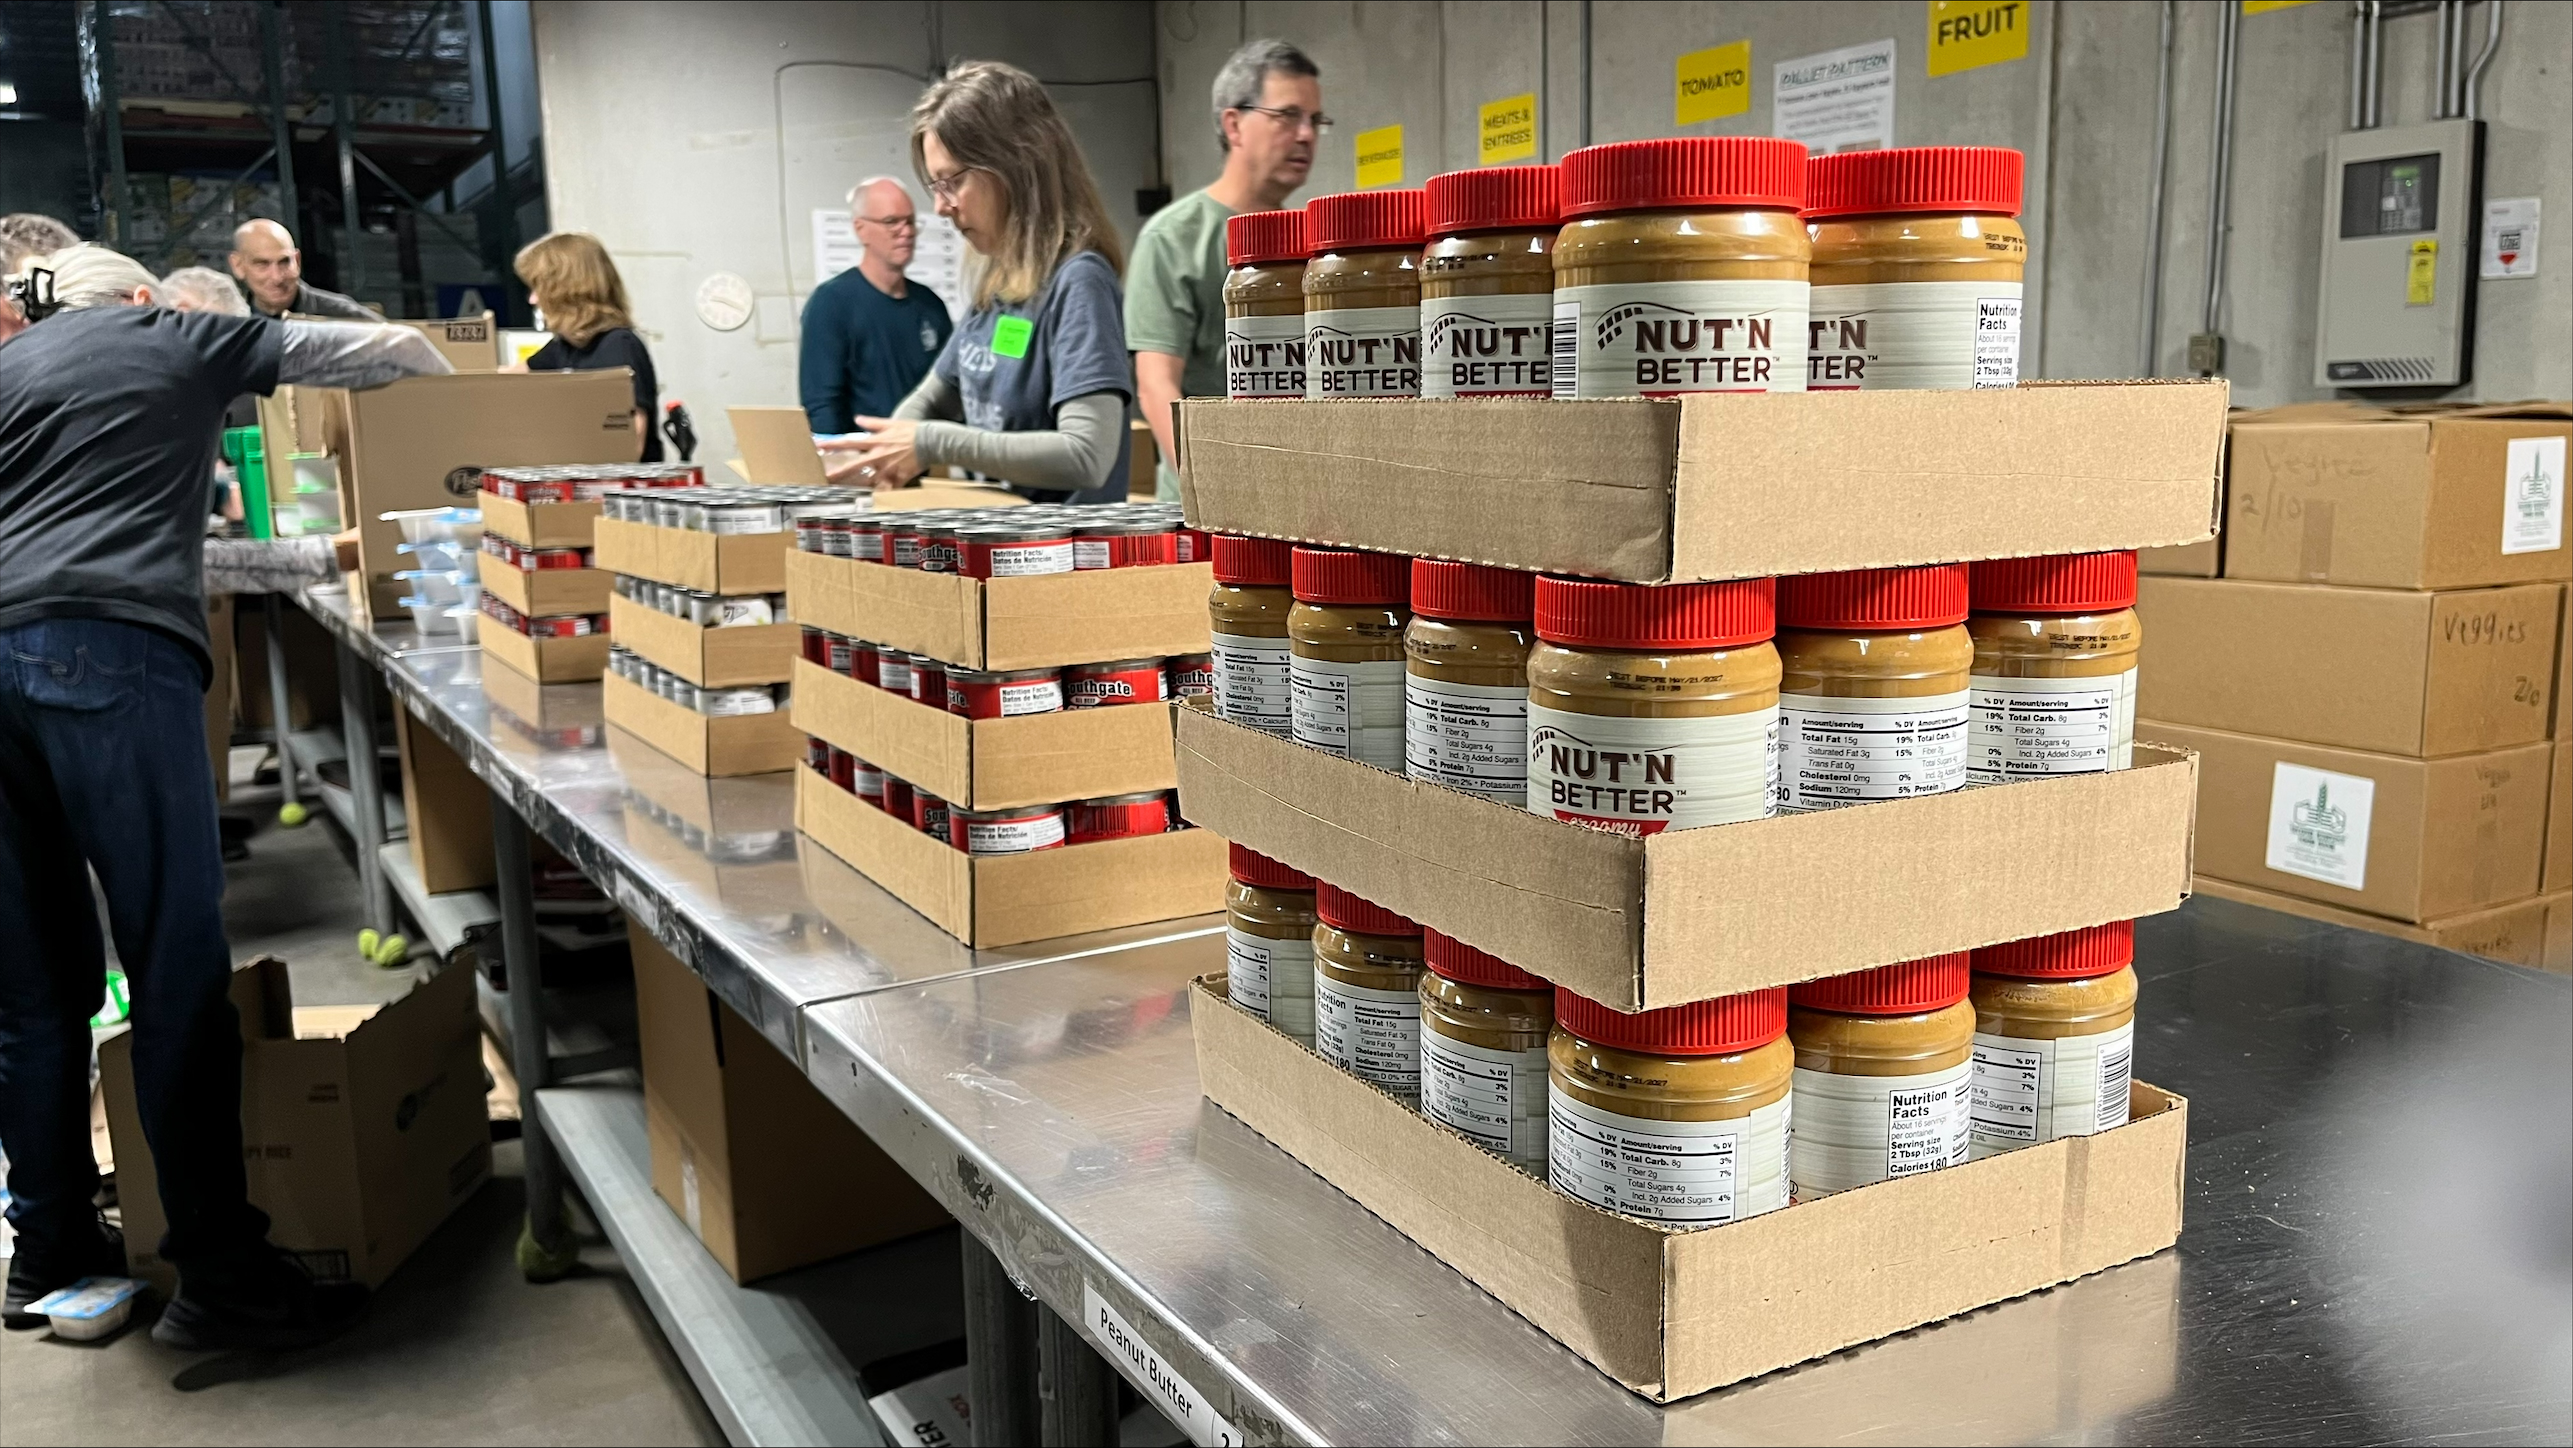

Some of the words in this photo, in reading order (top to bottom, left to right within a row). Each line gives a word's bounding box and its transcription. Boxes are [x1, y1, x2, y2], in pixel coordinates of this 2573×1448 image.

[1937, 3, 2019, 47] FRUIT
[1681, 69, 1746, 97] TOMATO
[1980, 304, 2017, 317] Nutrition
[1979, 318, 2007, 331] Facts
[1635, 318, 1773, 352] NUT'N
[1808, 318, 1868, 350] T'N
[1230, 343, 1305, 368] NUT'N
[1320, 337, 1419, 367] NUT'N
[1807, 355, 1865, 380] TER
[1977, 356, 2003, 366] Serving
[1453, 362, 1549, 385] BETTE
[1636, 356, 1771, 385] BETTER
[1976, 367, 1982, 376] 2
[1231, 371, 1306, 392] BETTER
[1322, 369, 1418, 392] BETTER
[1635, 675, 1667, 684] BEFORE
[1066, 681, 1132, 697] outhgate
[2009, 700, 2069, 708] Amount/serving
[1440, 714, 1457, 724] Total
[1458, 717, 1479, 726] Carb.
[1801, 718, 1864, 729] Amount/serving
[1985, 712, 2004, 721] 19%
[2009, 713, 2031, 722] Total
[2033, 714, 2056, 722] Carb.
[1984, 724, 2003, 733] 15%
[2015, 726, 2034, 734] Fiber
[2035, 727, 2045, 735] 2g
[1801, 733, 1824, 742] Total
[1825, 735, 1841, 743] Fat
[1844, 736, 1858, 745] 15g
[1896, 736, 1913, 744] 19%
[1917, 735, 1935, 743] Total
[2014, 738, 2033, 746] Total
[2034, 739, 2060, 748] Sugars
[2061, 739, 2070, 747] 4g
[1460, 741, 1483, 751] Sugars
[1484, 743, 1493, 752] 4g
[1807, 747, 1845, 757] Saturated
[1846, 749, 1859, 757] Fat
[1860, 749, 1870, 758] 3g
[1895, 749, 1913, 757] 15%
[1471, 753, 1493, 763] Added
[1494, 755, 1519, 765] Sugars
[1988, 748, 2002, 756] 0%
[2019, 750, 2034, 758] Incl.
[2035, 751, 2045, 759] 2g
[2046, 750, 2069, 758] Added
[2070, 750, 2092, 759] Sugars
[1440, 761, 1464, 771] Protein
[1550, 744, 1676, 785] NUT'N
[1808, 759, 1829, 769] Trans
[1830, 760, 1843, 769] Fat
[1844, 762, 1855, 771] 0g
[1987, 760, 2002, 768] 5%
[2006, 761, 2038, 770] Protein
[1799, 771, 1851, 782] Cholesterol
[1853, 775, 1870, 784] 0mg
[1480, 780, 1522, 790] Potassium
[1799, 782, 1832, 793] Sodium
[1835, 786, 1861, 796] 120mg
[1898, 786, 1911, 794] 5%
[1914, 783, 1939, 793] Protein
[1551, 779, 1674, 815] BETTER
[1800, 798, 1831, 808] Vitamin
[1354, 1016, 1371, 1025] Total
[1372, 1019, 1384, 1027] Fat
[1385, 1021, 1397, 1029] 15g
[1354, 1046, 1394, 1058] Cholesterol
[1394, 1052, 1409, 1060] 0mg
[1381, 1060, 1402, 1069] 120mg
[2021, 1083, 2034, 1091] 7%
[1893, 1090, 1948, 1107] Nutrition
[1892, 1106, 1930, 1119] Facts
[1989, 1101, 2014, 1111] Sugars
[2019, 1105, 2033, 1113] 4%
[1891, 1121, 1912, 1131] About
[1914, 1119, 1923, 1128] 16
[1974, 1121, 2016, 1136] Potassium
[2017, 1129, 2031, 1137] 4%
[1891, 1132, 1903, 1141] per
[1904, 1128, 1935, 1139] container
[1620, 1137, 1683, 1152] Amount/serving
[1891, 1139, 1925, 1150] Serving
[1926, 1137, 1941, 1146] size
[1600, 1146, 1617, 1158] 19%
[1620, 1152, 1643, 1163] Total
[1645, 1156, 1670, 1167] Carb.
[1671, 1159, 1682, 1169] 8g
[1719, 1157, 1732, 1165] 3%
[1891, 1151, 1897, 1159] 2
[1899, 1150, 1921, 1159] Tbsp
[1922, 1144, 1942, 1157] (32g)
[1600, 1159, 1617, 1170] 15%
[1627, 1166, 1646, 1177] Fiber
[1647, 1169, 1658, 1180] 2g
[1719, 1170, 1732, 1178] 7%
[1890, 1161, 1929, 1173] Calories
[1930, 1156, 1948, 1171] 180
[1627, 1178, 1646, 1189] Total
[1647, 1182, 1674, 1193] Sugars
[1675, 1184, 1686, 1193] 4g
[1632, 1191, 1646, 1201] Incl.
[1649, 1194, 1659, 1204] 2g
[1660, 1195, 1685, 1204] Added
[1687, 1196, 1713, 1206] Sugars
[1718, 1194, 1731, 1202] 4%
[1620, 1200, 1651, 1214] Protein
[1653, 1207, 1664, 1217] 7g
[1100, 1307, 1146, 1372] Peanut
[1149, 1356, 1193, 1419] Butter
